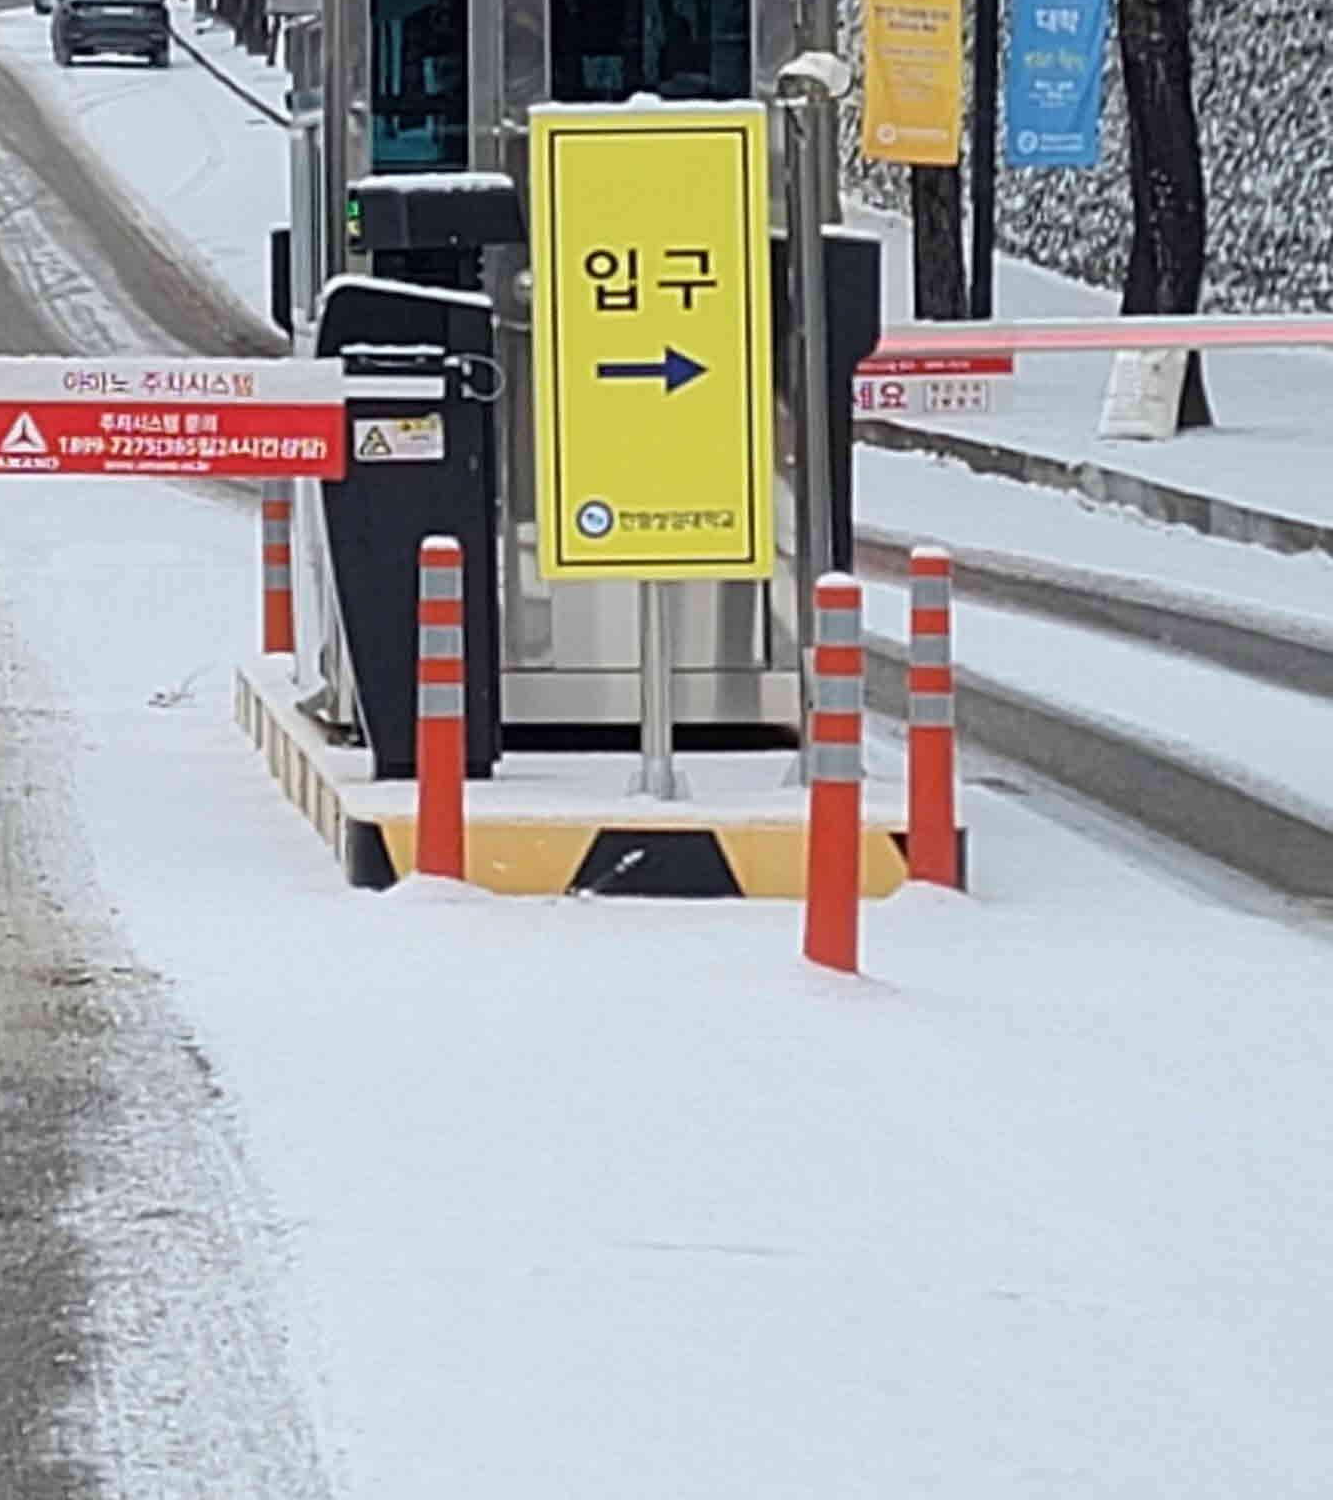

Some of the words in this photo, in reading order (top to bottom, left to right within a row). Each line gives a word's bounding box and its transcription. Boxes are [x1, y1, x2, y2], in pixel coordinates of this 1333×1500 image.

[1035, 8, 1078, 34] 대학
[584, 247, 716, 312] 입구
[63, 370, 130, 394] 아마노
[140, 371, 253, 397] 주차시스템
[99, 413, 180, 435] 주차시스템
